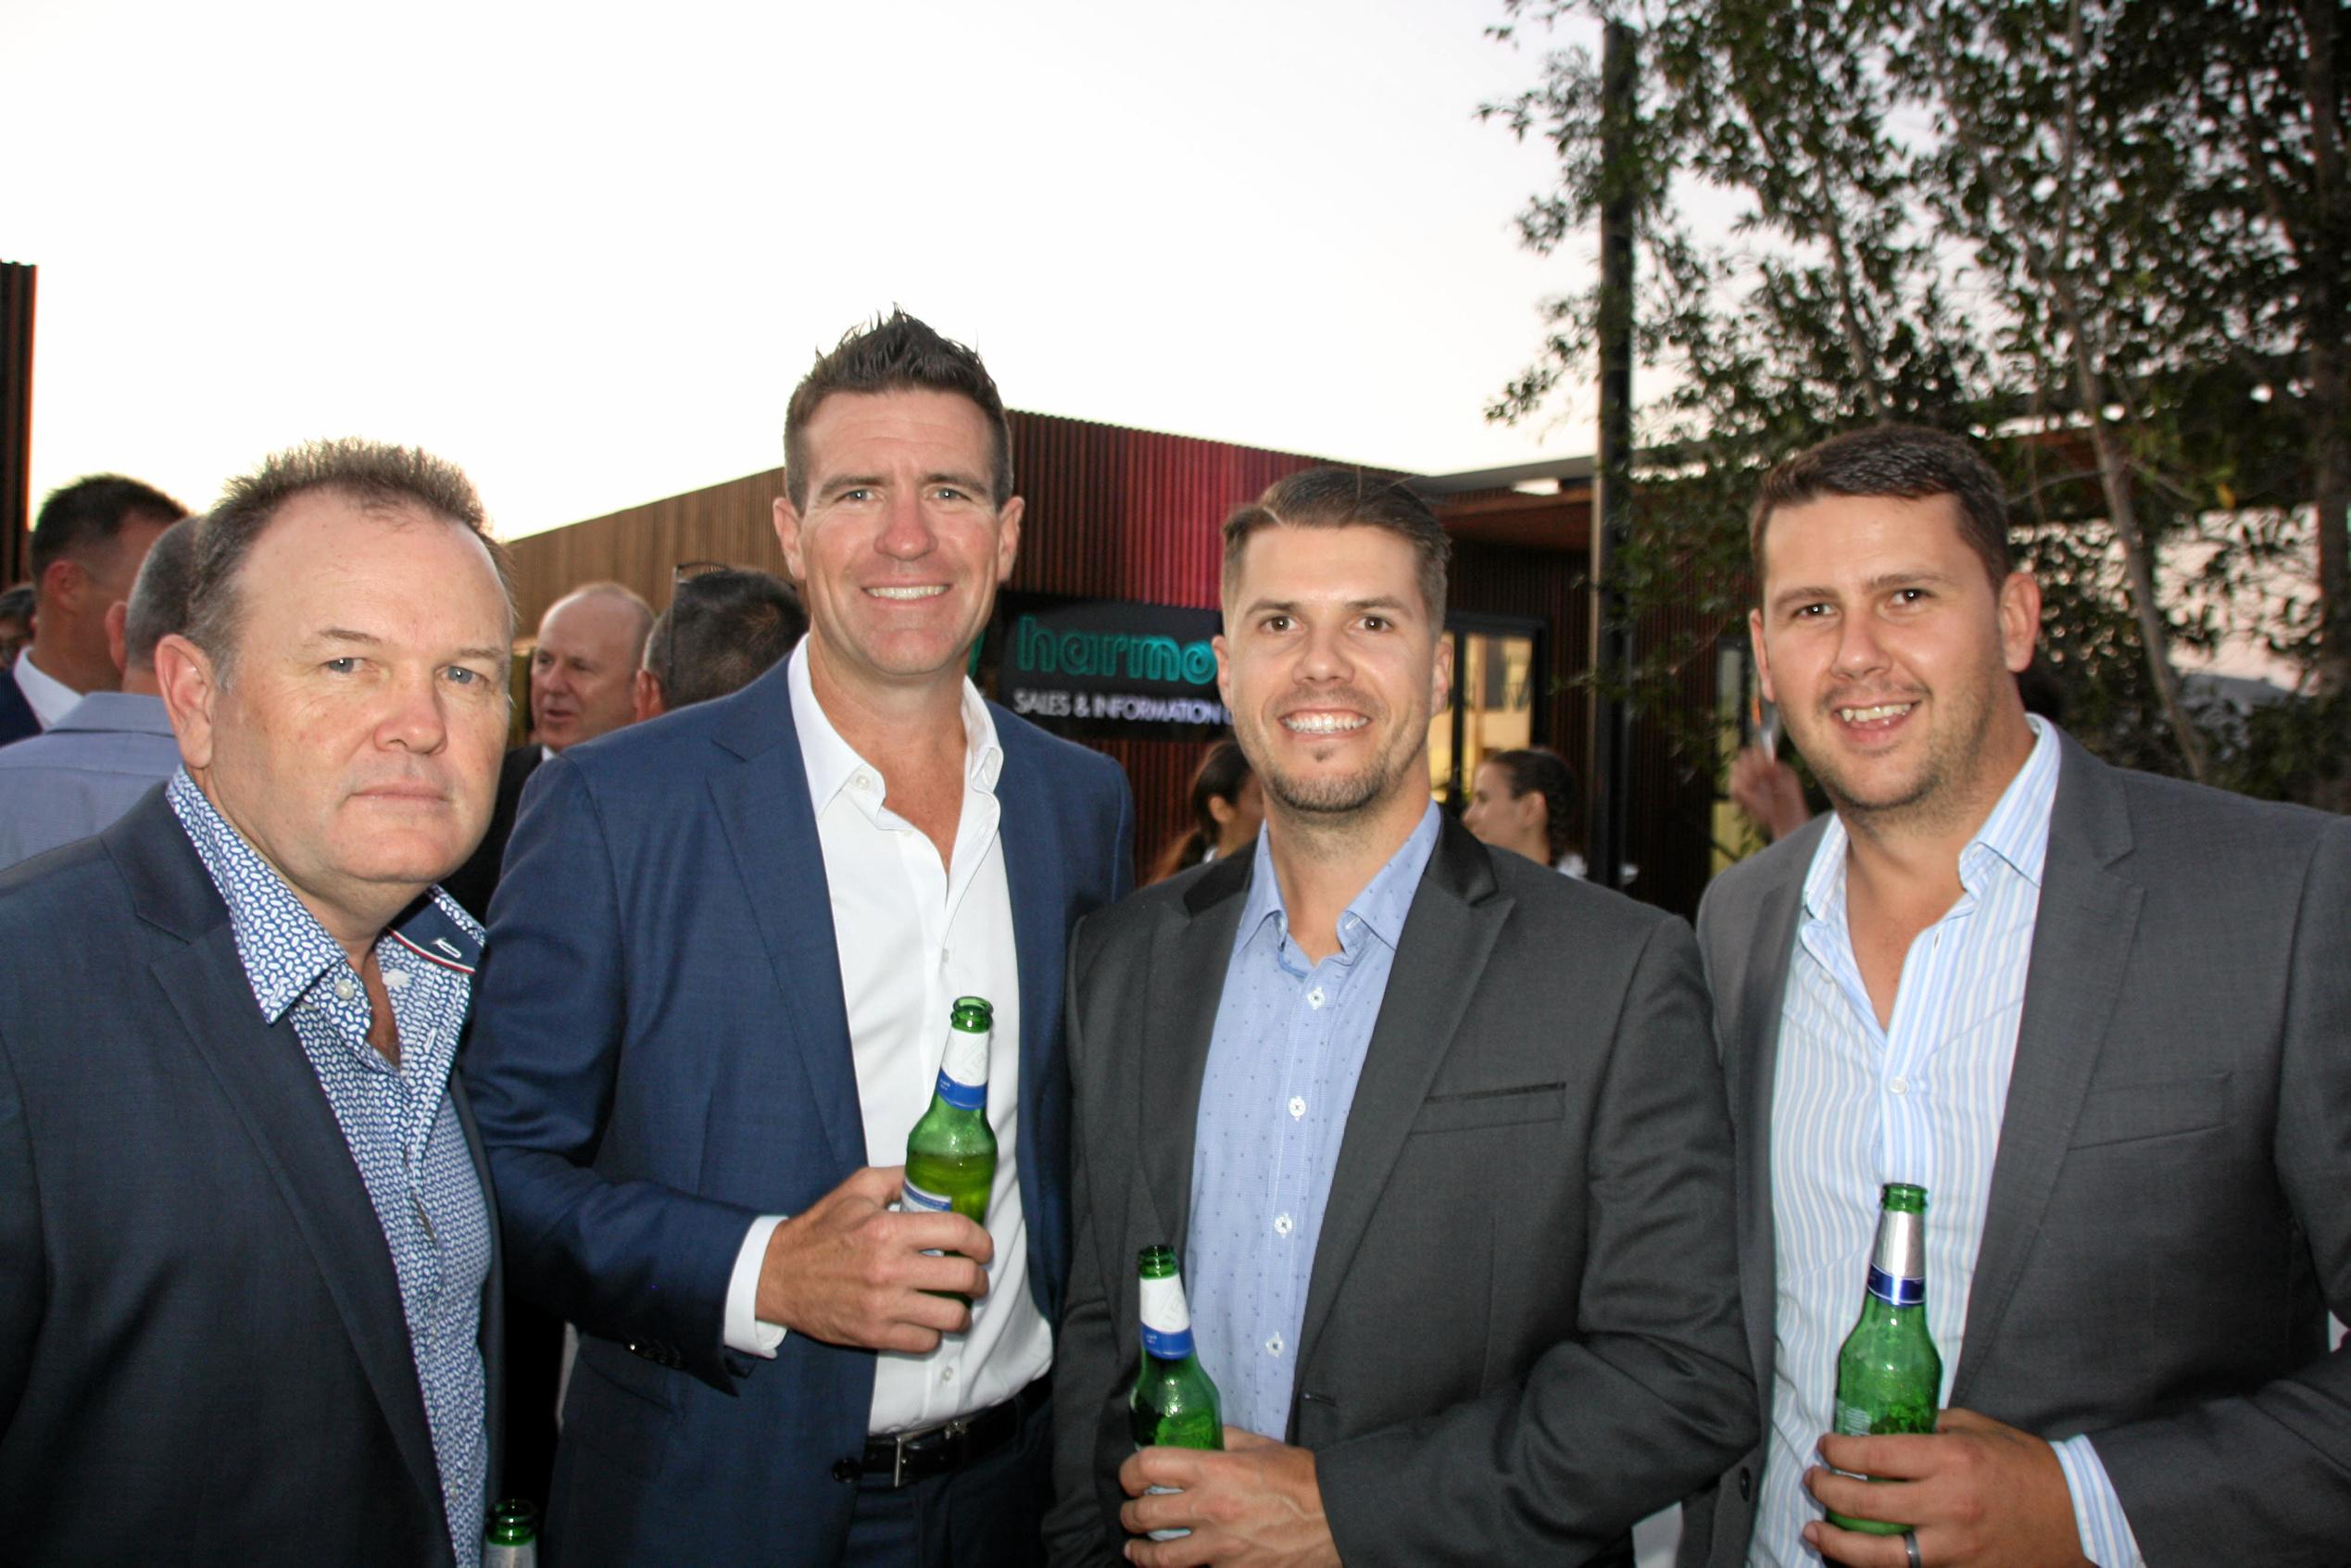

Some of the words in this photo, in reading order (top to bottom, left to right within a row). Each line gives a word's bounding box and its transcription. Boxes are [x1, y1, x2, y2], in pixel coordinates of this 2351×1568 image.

[1018, 614, 1218, 684] harmo
[1013, 689, 1071, 717] SALES
[1073, 693, 1090, 718] &
[1092, 695, 1222, 725] INFORMATION
